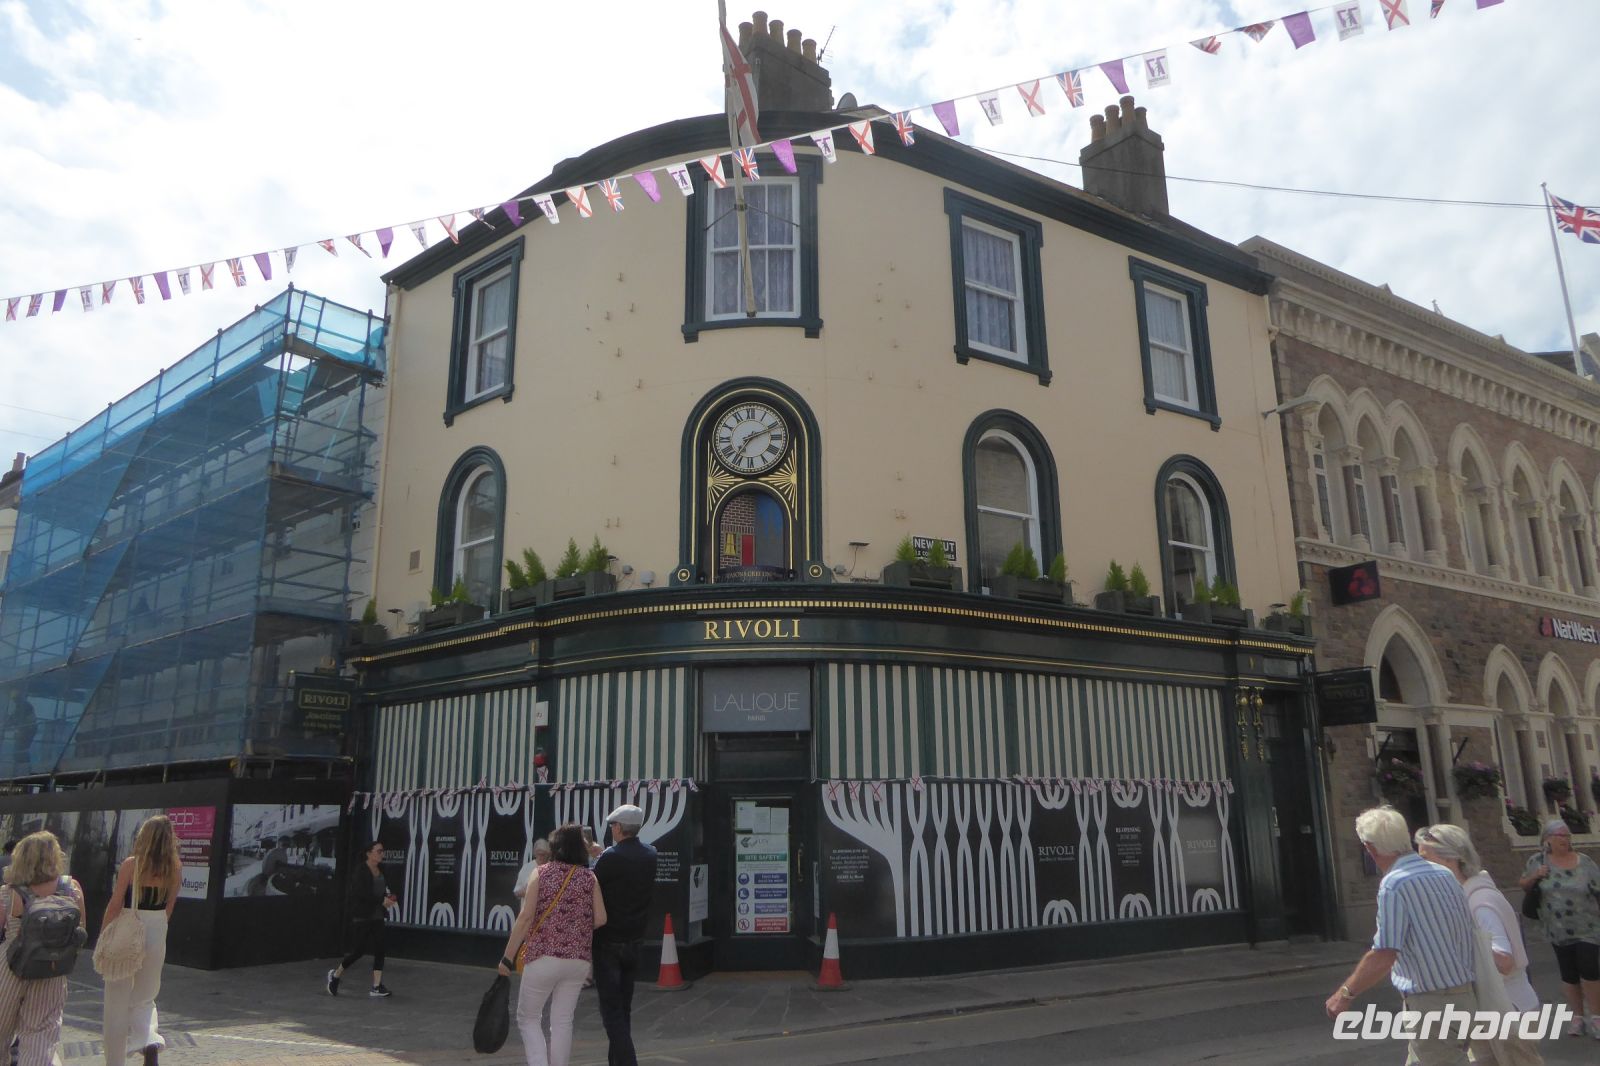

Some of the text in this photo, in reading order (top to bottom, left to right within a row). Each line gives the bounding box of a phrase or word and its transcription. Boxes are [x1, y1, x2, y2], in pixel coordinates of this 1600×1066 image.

[914, 538, 934, 549] NEW
[703, 619, 801, 640] RIVOLI
[1552, 618, 1597, 643] NatWest
[304, 694, 345, 705] RIVOLI
[713, 692, 801, 713] LALIQUE
[490, 850, 519, 860] RIVOLI
[1038, 845, 1075, 856] RIVOLI
